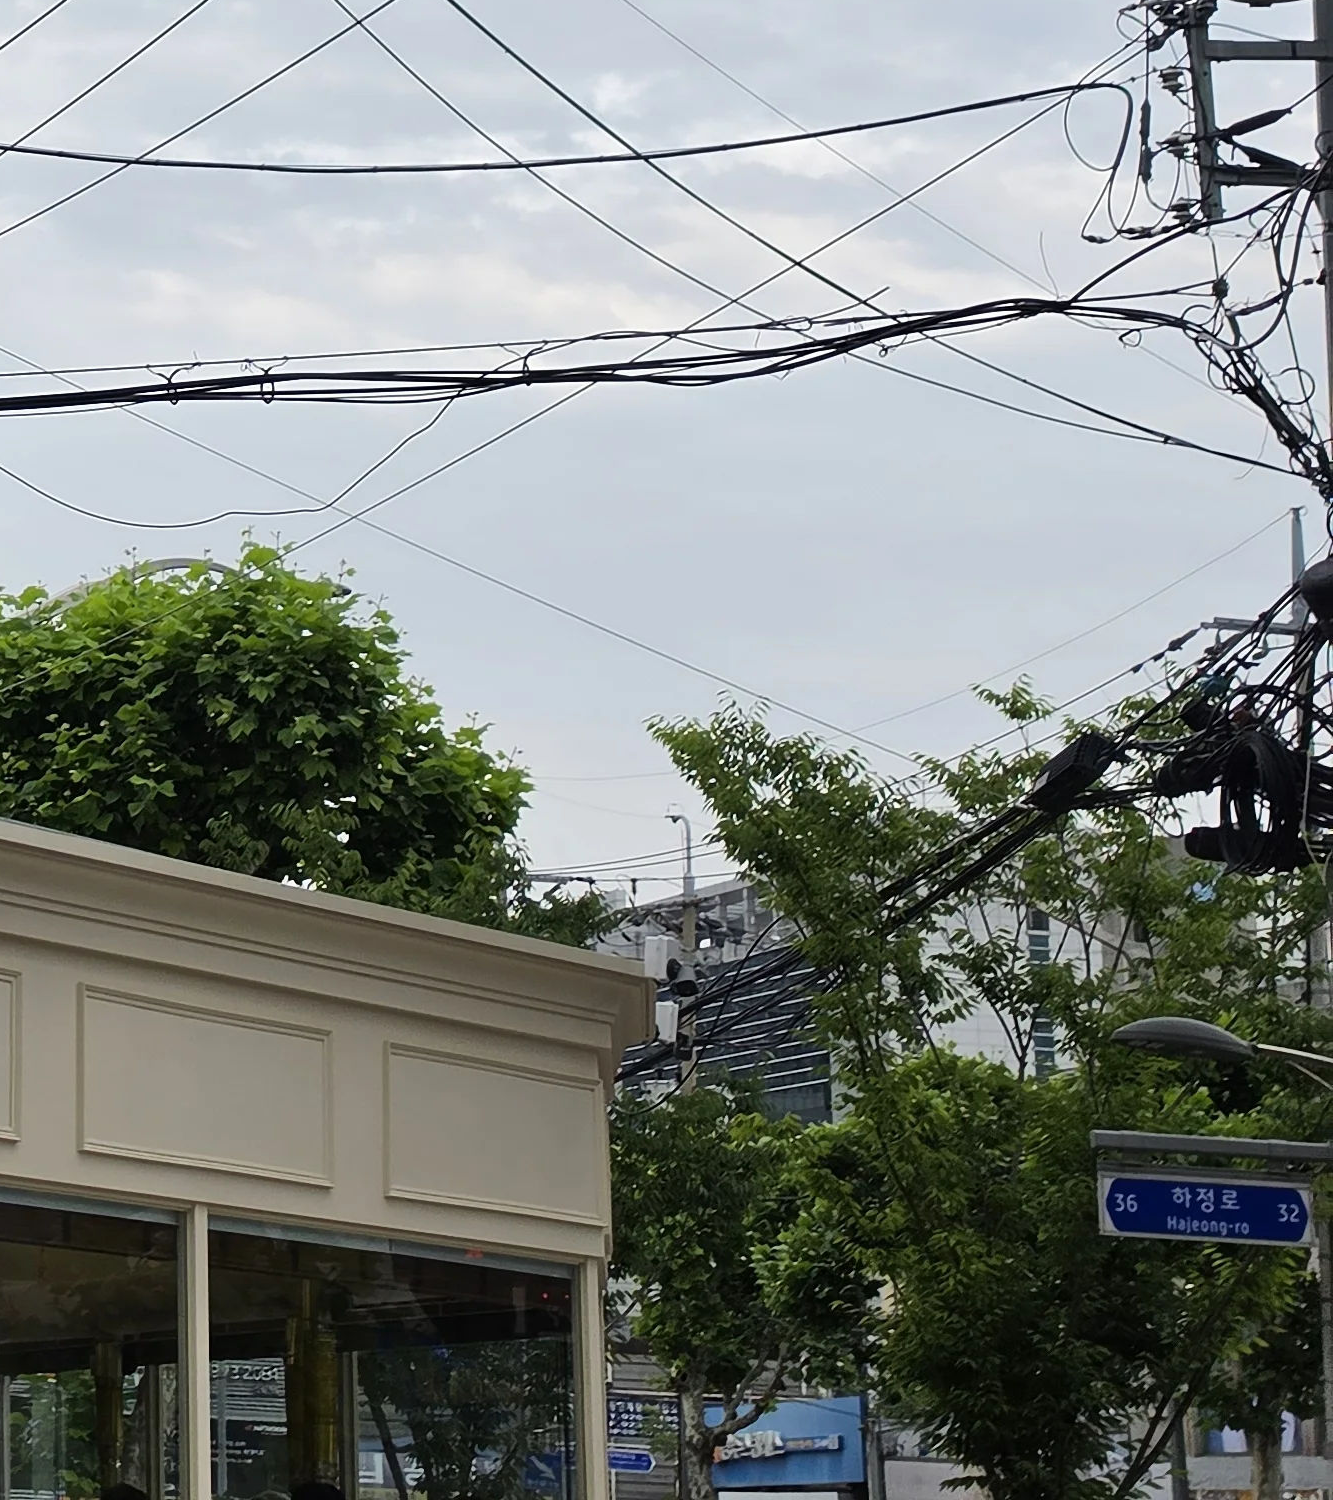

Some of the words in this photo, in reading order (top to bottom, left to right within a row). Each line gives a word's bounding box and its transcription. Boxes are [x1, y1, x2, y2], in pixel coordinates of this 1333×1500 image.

[1113, 1193, 1138, 1212] 36
[1171, 1186, 1241, 1213] 하정로
[1276, 1203, 1300, 1223] 32
[1166, 1215, 1250, 1236] Hajeong-ro
